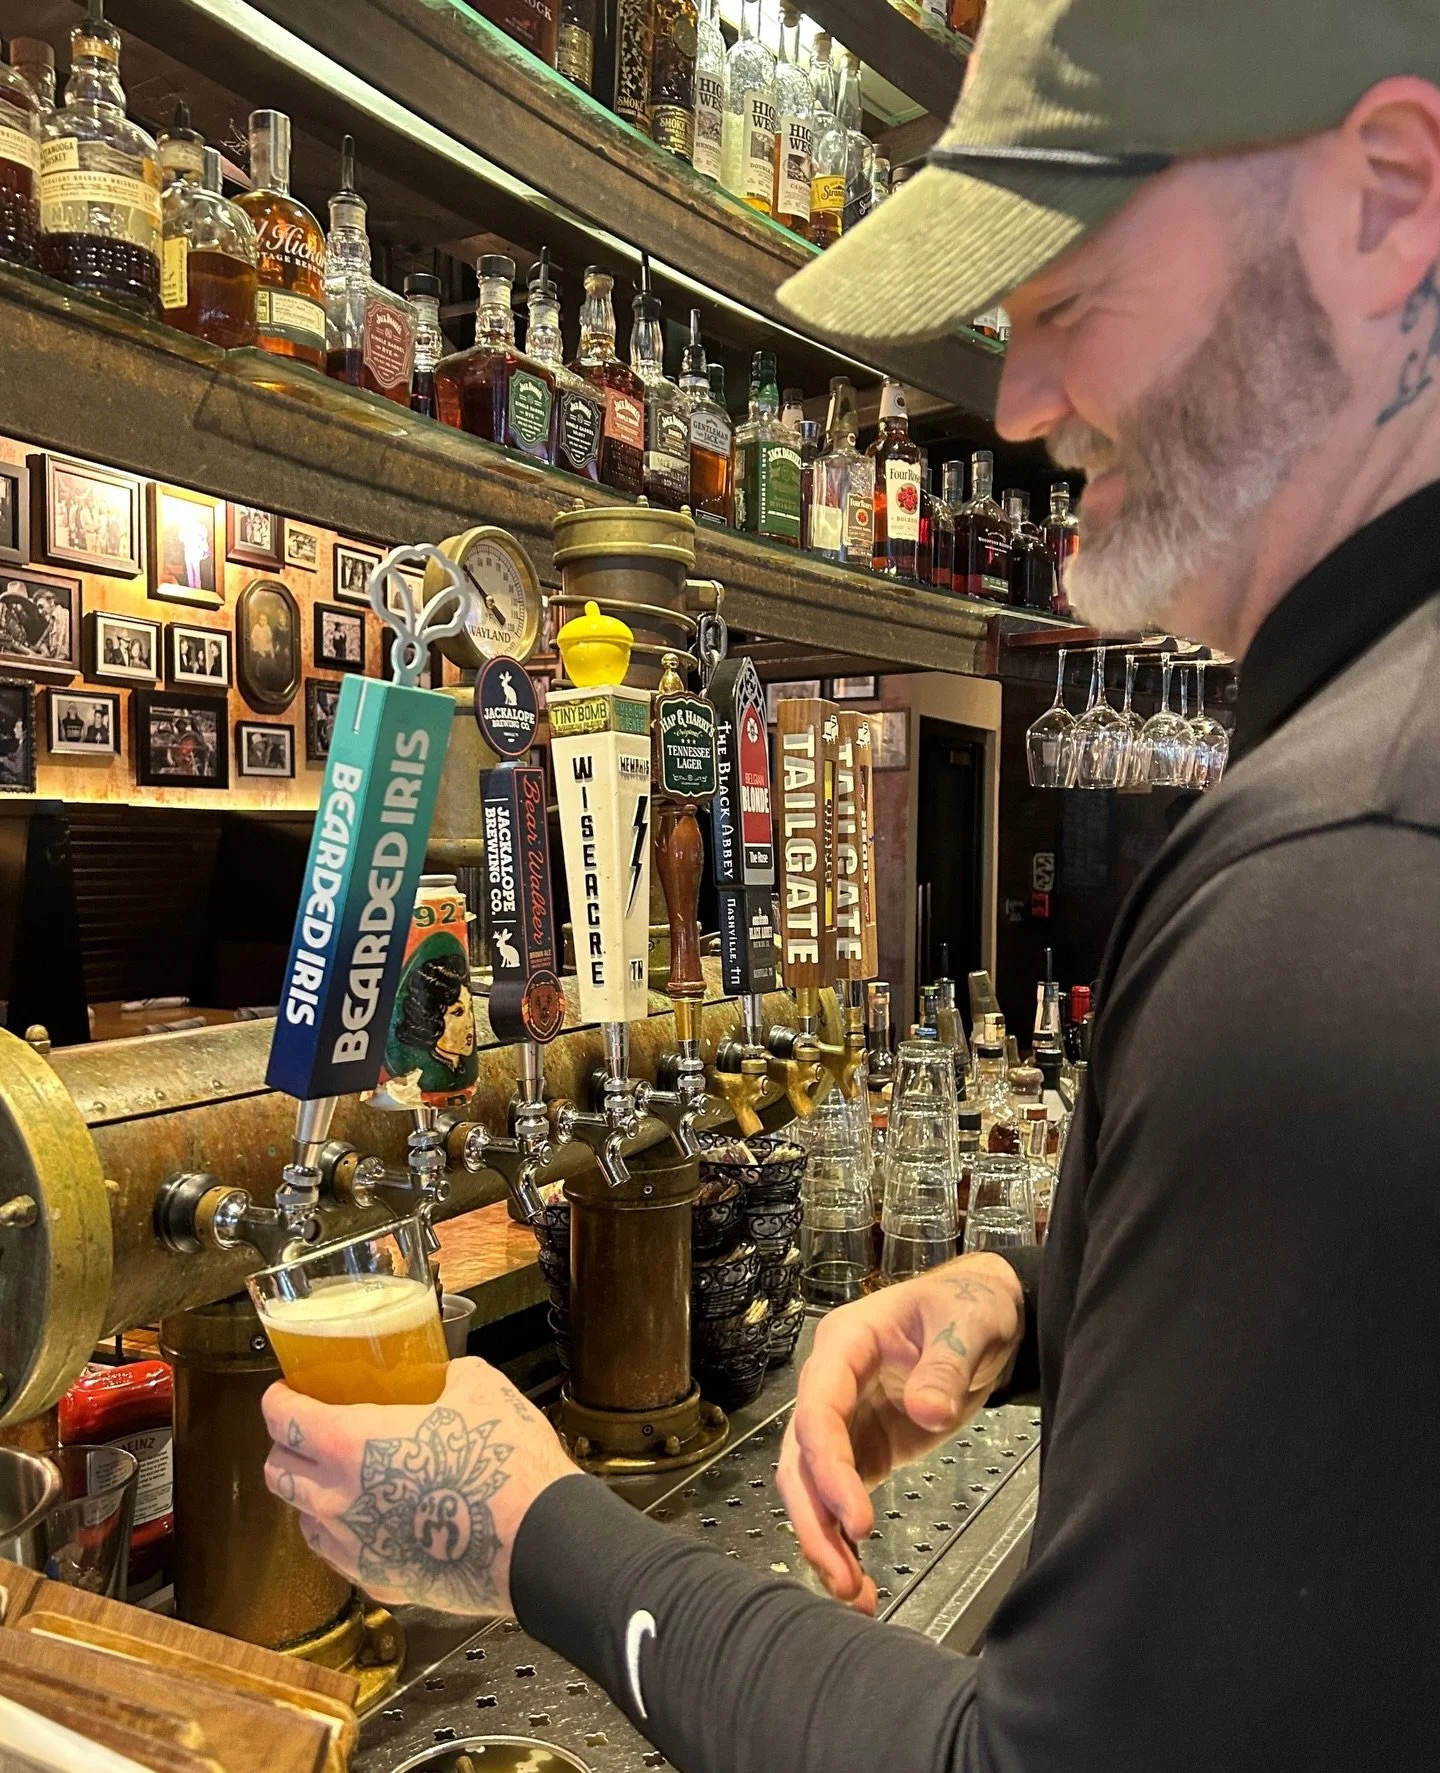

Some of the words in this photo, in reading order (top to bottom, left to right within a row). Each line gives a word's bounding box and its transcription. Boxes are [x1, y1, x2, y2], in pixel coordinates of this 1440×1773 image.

[699, 77, 724, 99] HIG
[617, 95, 645, 112] SMOKE
[699, 93, 724, 113] WES
[752, 100, 778, 123] HIG
[659, 117, 686, 132] SMOKE
[752, 114, 777, 135] WES
[789, 123, 814, 145] HIG
[789, 137, 814, 157] WES
[693, 421, 729, 442] GENTLEMAN
[704, 432, 719, 445] JACK
[767, 447, 783, 462] JACK
[890, 468, 908, 480] Four
[468, 624, 512, 643] WAYLAND
[483, 707, 536, 724] JACKALOPE
[552, 705, 578, 725] TINY
[577, 702, 607, 722] BOMB
[660, 712, 677, 733] HAP
[677, 709, 686, 727] &
[685, 709, 716, 738] HARRY'S
[492, 719, 520, 728] BREWING
[520, 722, 531, 731] CO.
[716, 721, 732, 756] THE
[667, 744, 711, 759] TENNESSEE
[619, 756, 650, 776] MEMPHIS
[676, 758, 703, 770] LAGER
[744, 772, 765, 786] BELGIAN
[717, 762, 731, 821] BLACK
[741, 785, 770, 814] BLONDE
[521, 775, 542, 847] Bear
[301, 762, 364, 950] BEARDED
[484, 807, 501, 884] BREWING
[721, 824, 735, 880] ABBEY
[782, 725, 819, 965] TAILGATE
[861, 809, 870, 885] CIDER
[496, 806, 516, 913] JACKALOPE
[749, 851, 758, 864] The
[757, 851, 769, 864] Rose
[572, 756, 606, 985] WISEACRE
[331, 830, 409, 1064] BEARDED
[379, 727, 432, 825] IRIS
[490, 888, 503, 916] CO.
[527, 849, 547, 947] Walker
[630, 960, 644, 980] TN
[285, 948, 326, 1027] IRIS
